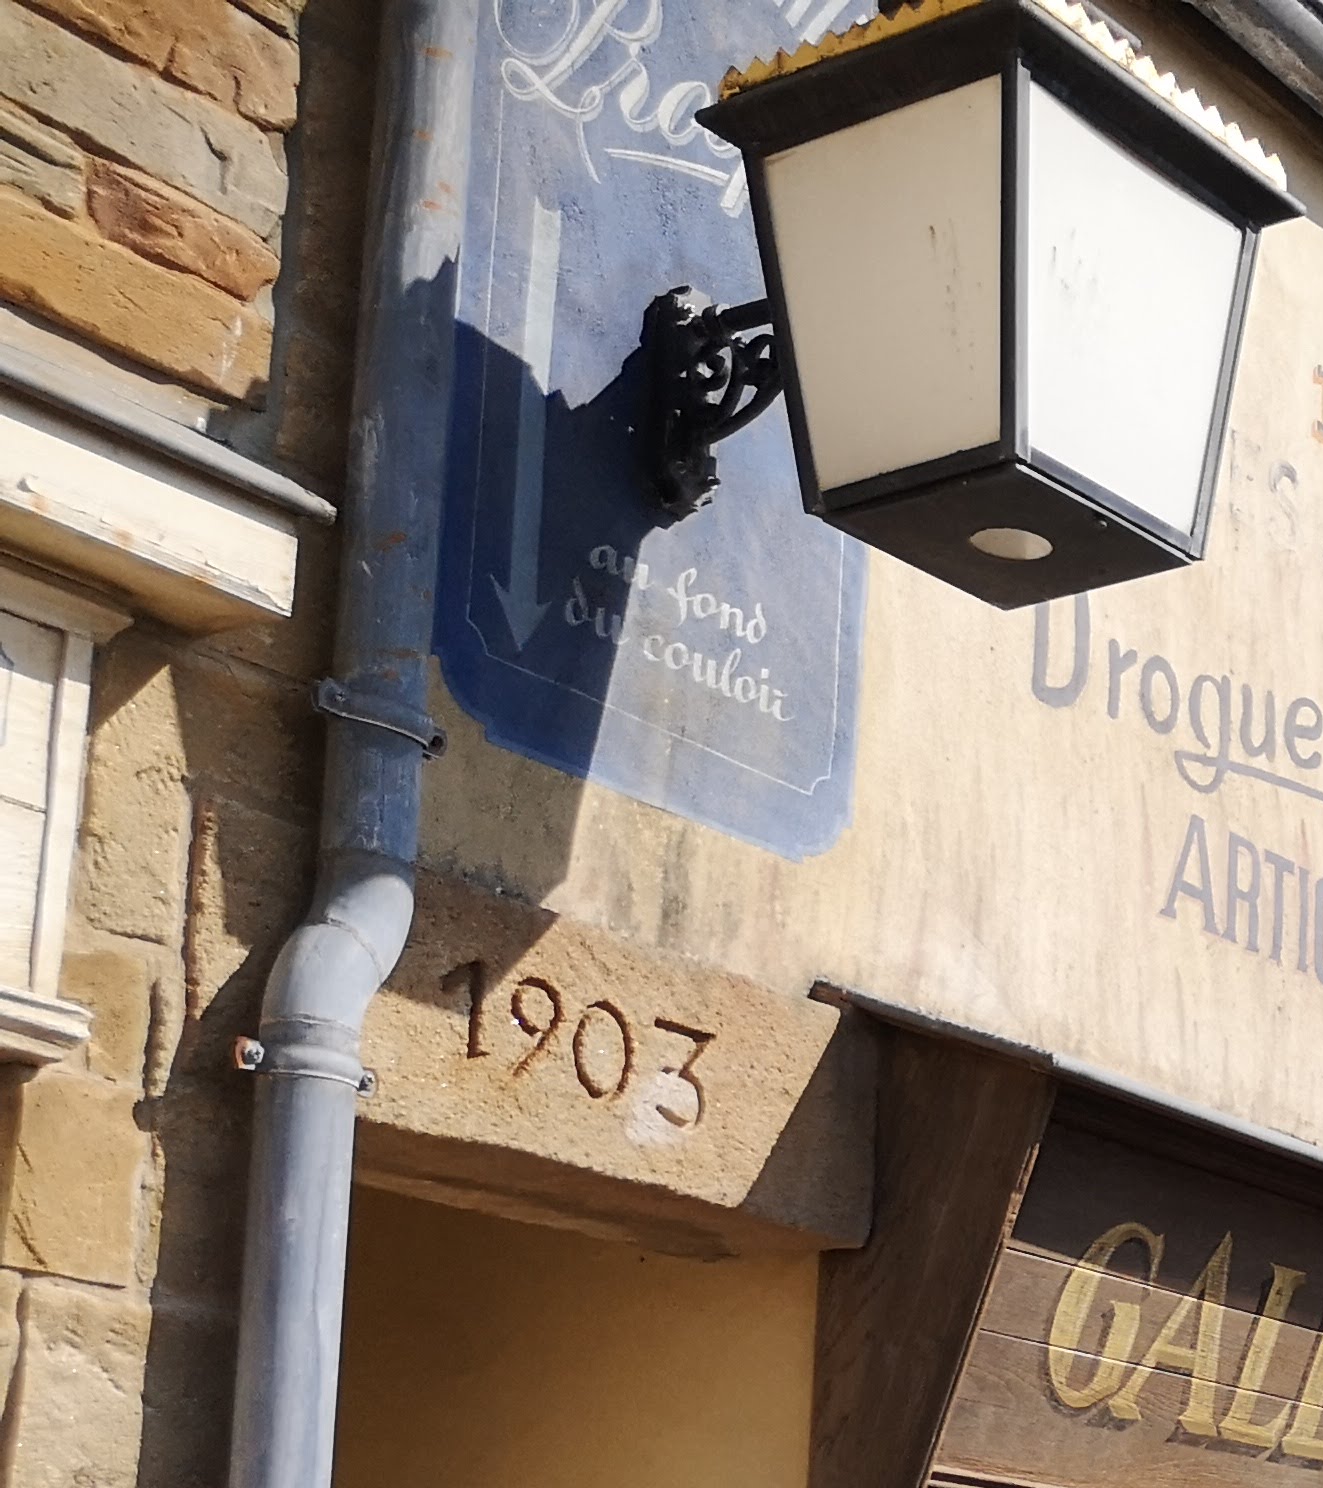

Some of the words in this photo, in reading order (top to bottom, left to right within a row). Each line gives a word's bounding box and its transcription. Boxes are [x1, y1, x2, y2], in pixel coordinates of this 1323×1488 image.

[565, 576, 630, 645] du
[643, 635, 796, 722] couloir
[589, 545, 654, 590] au
[667, 567, 767, 644] fond
[441, 960, 717, 1129] 1903
